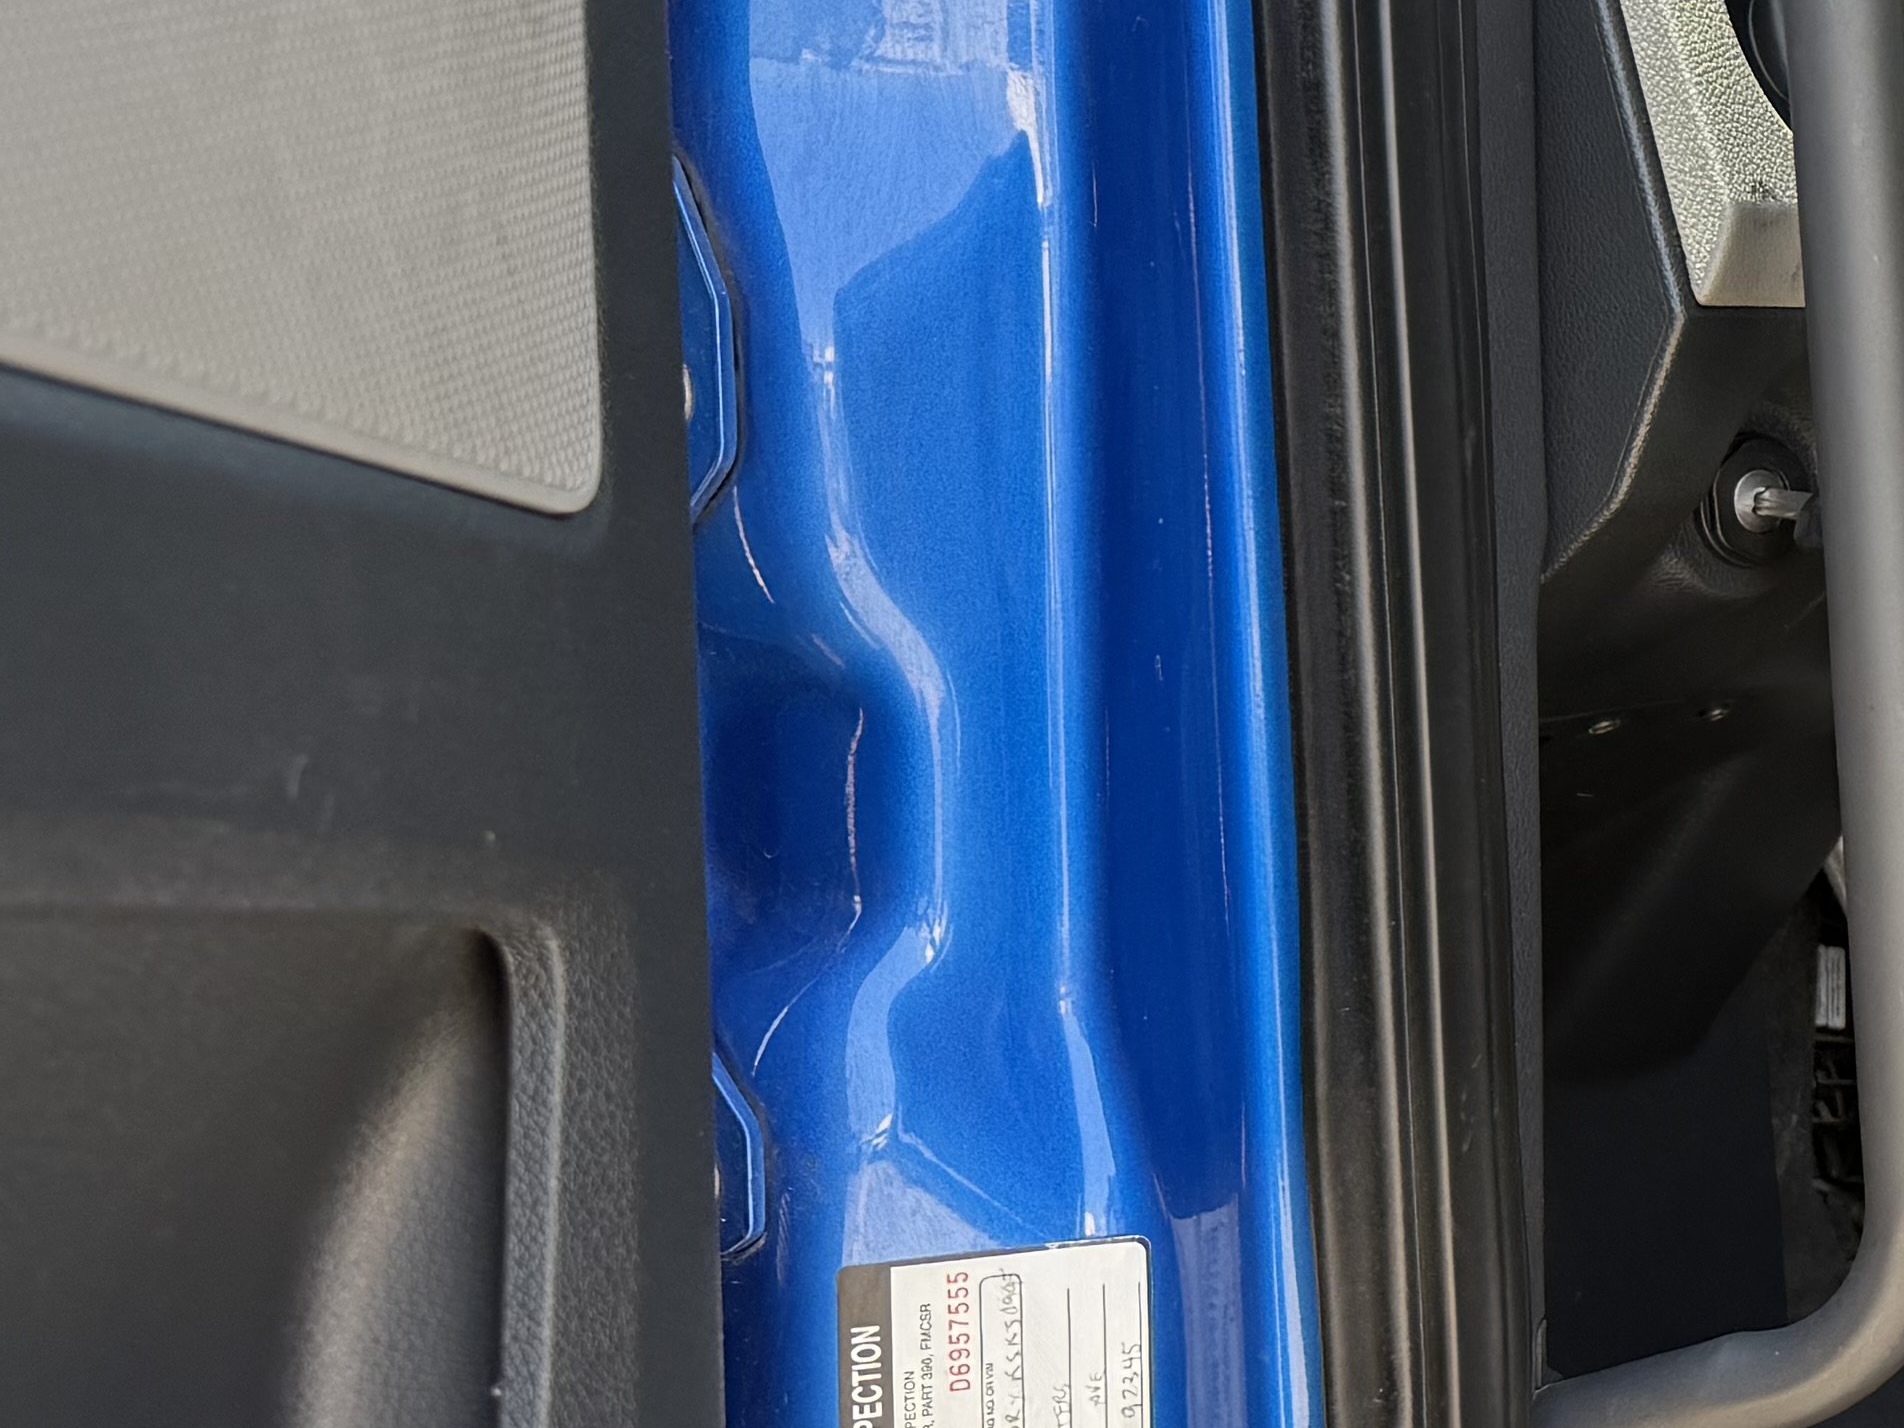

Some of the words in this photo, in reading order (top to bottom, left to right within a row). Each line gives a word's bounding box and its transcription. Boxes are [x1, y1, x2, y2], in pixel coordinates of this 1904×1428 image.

[919, 1303, 932, 1350] FMCSR
[946, 1272, 971, 1391] D6957555
[921, 1385, 933, 1416] PART
[1121, 1342, 1142, 1418] 92345
